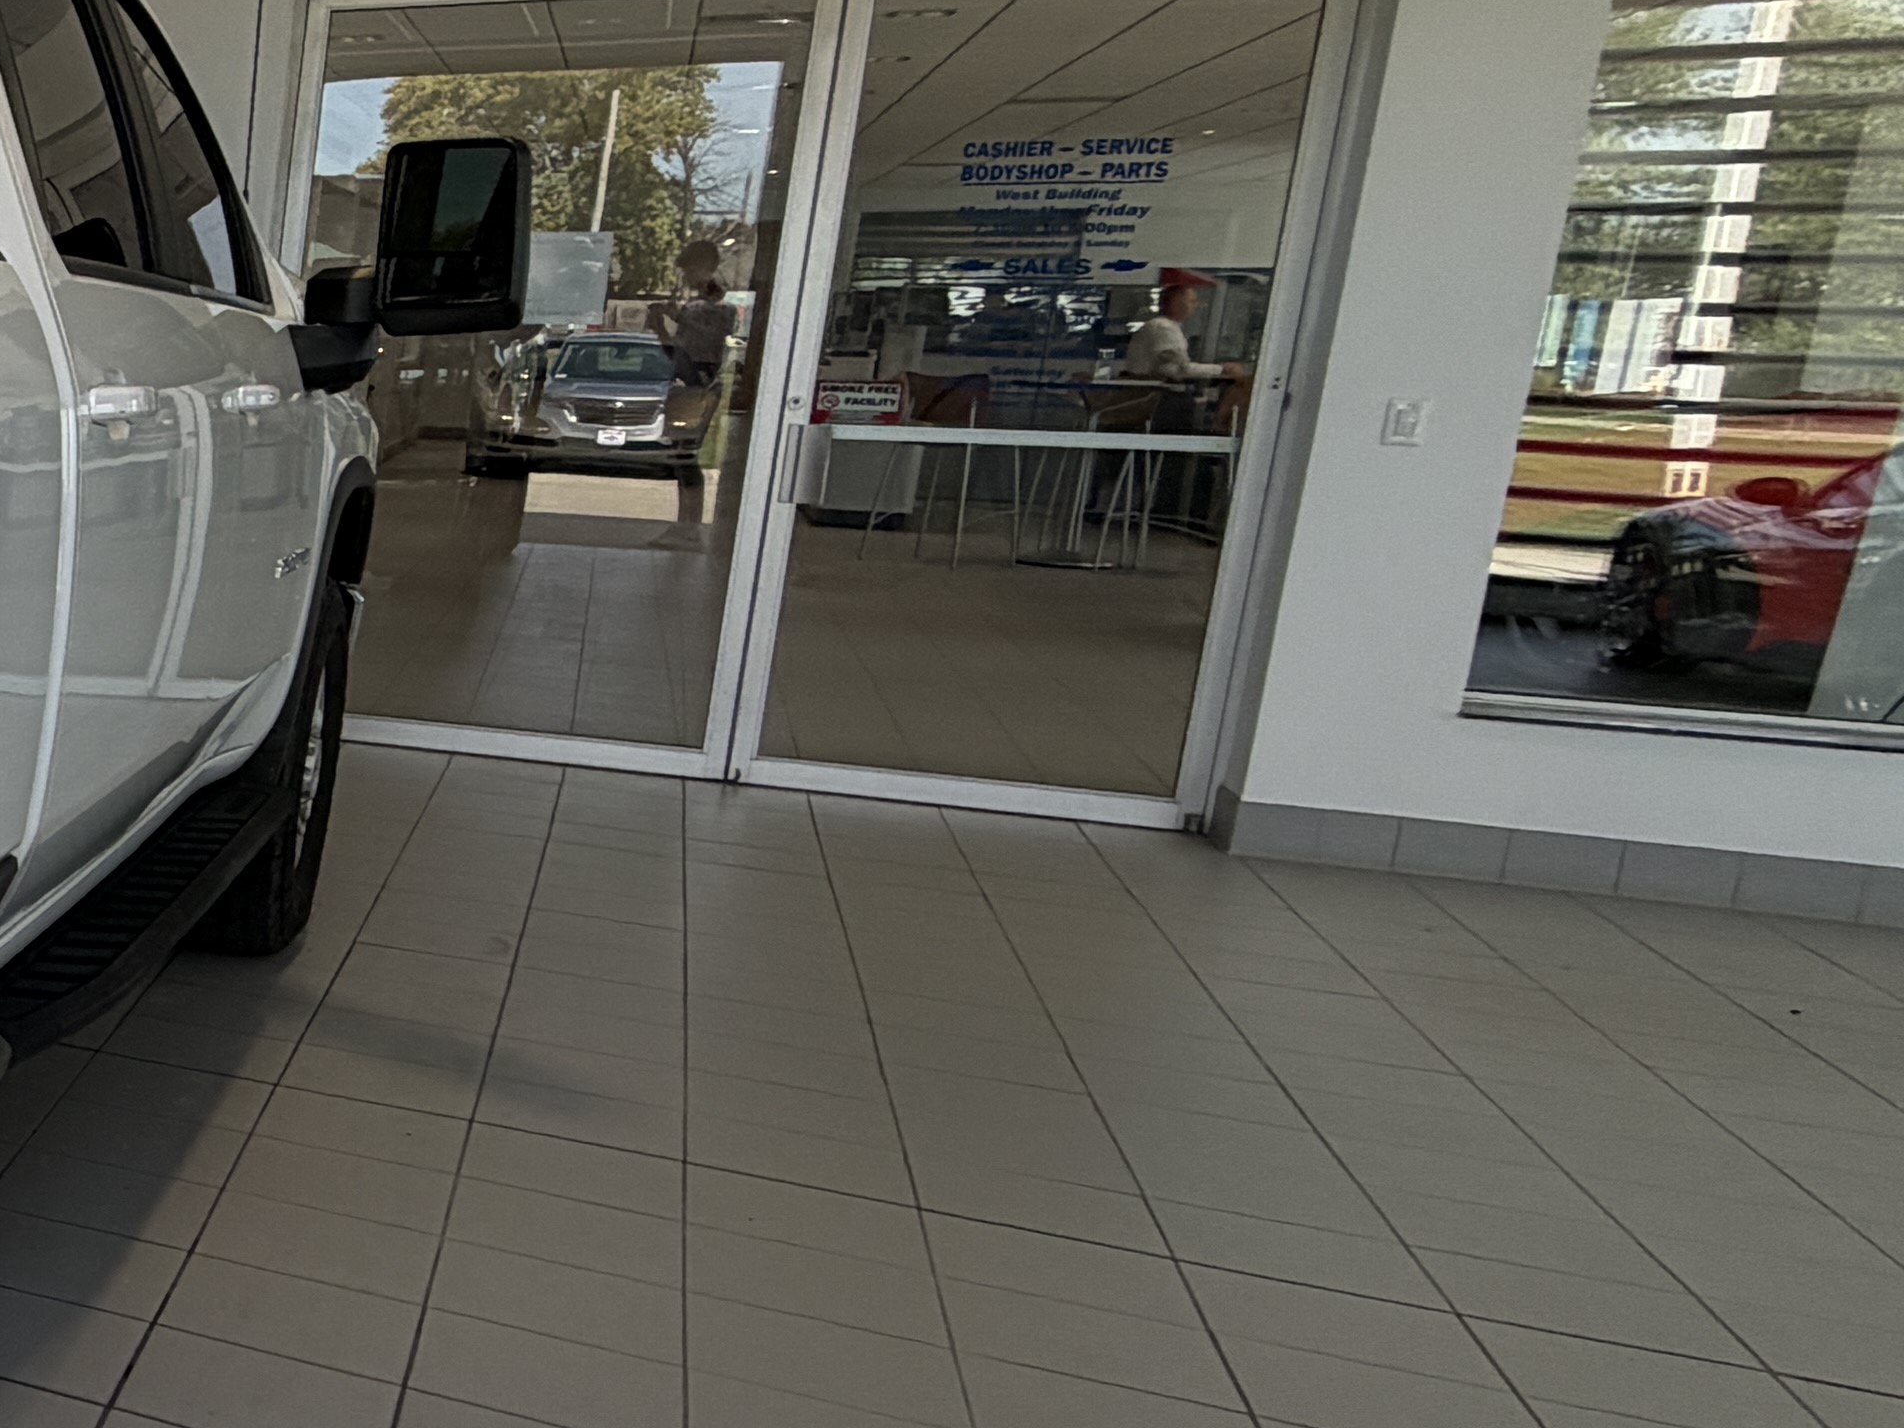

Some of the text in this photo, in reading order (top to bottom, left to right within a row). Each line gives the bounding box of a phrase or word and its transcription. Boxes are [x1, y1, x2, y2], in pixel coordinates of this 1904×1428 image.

[963, 141, 1054, 159] CASHIER
[1080, 137, 1174, 156] SERVICE
[960, 163, 1074, 181] BODYSHOP
[1100, 160, 1169, 178] PARTS
[996, 188, 1123, 201] West Building
[1088, 203, 1151, 218] Friday
[1004, 258, 1092, 274] SALES
[844, 397, 897, 406] FACILITY
